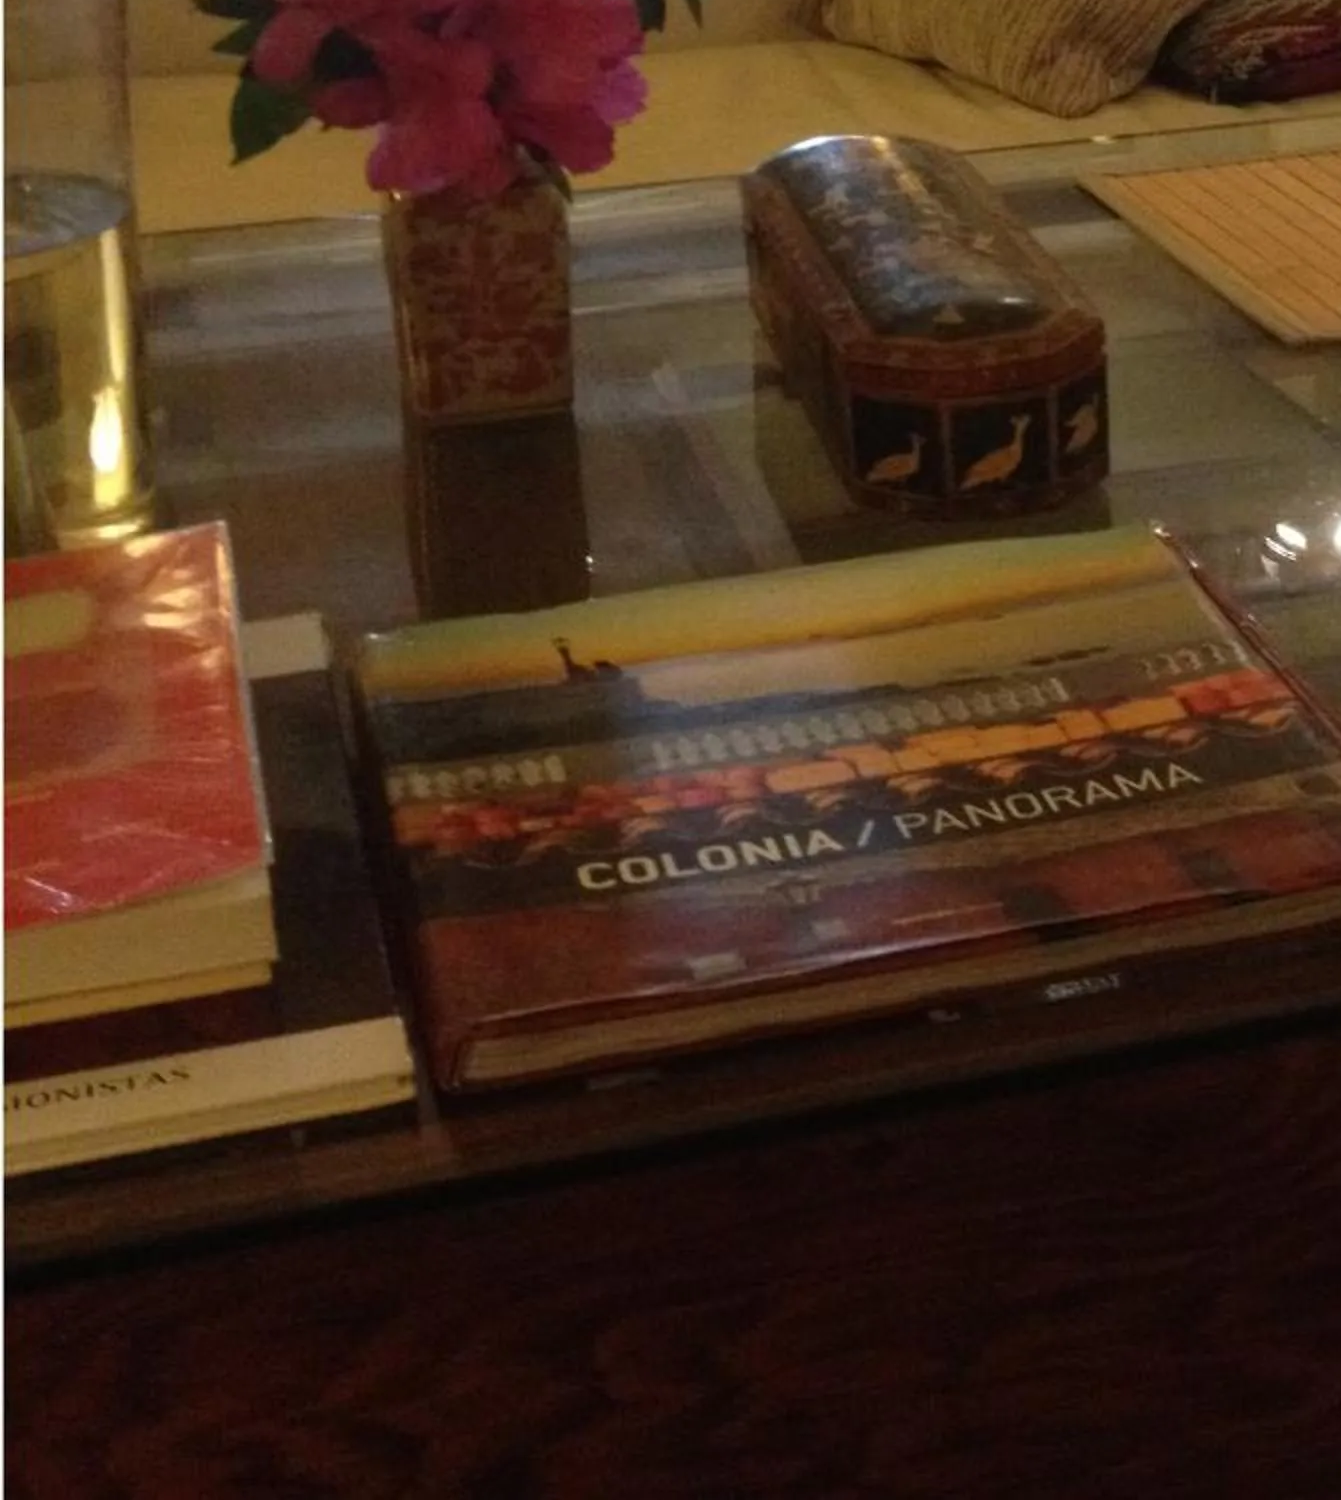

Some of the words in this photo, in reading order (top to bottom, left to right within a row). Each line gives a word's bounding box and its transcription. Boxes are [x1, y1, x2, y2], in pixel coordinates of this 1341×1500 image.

[576, 828, 846, 890] COLONIA
[892, 762, 1204, 840] PANORAMA
[4, 1066, 192, 1112] IONISTAS
